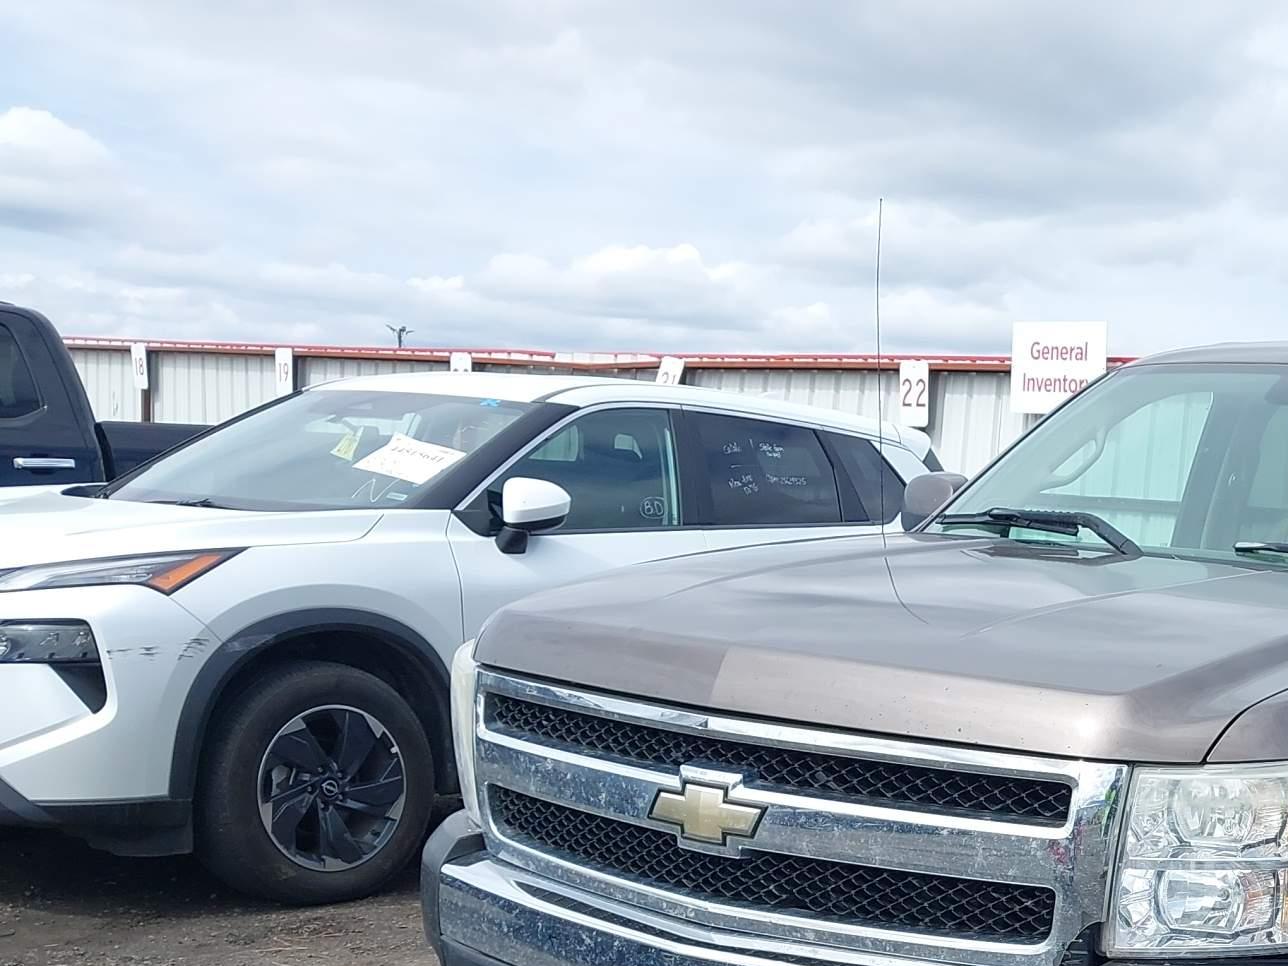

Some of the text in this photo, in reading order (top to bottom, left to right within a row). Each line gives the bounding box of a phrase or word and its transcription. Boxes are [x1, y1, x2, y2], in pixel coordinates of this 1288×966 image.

[1030, 341, 1089, 361] General
[134, 357, 145, 376] 18
[278, 362, 289, 383] 19
[902, 378, 926, 407] 22
